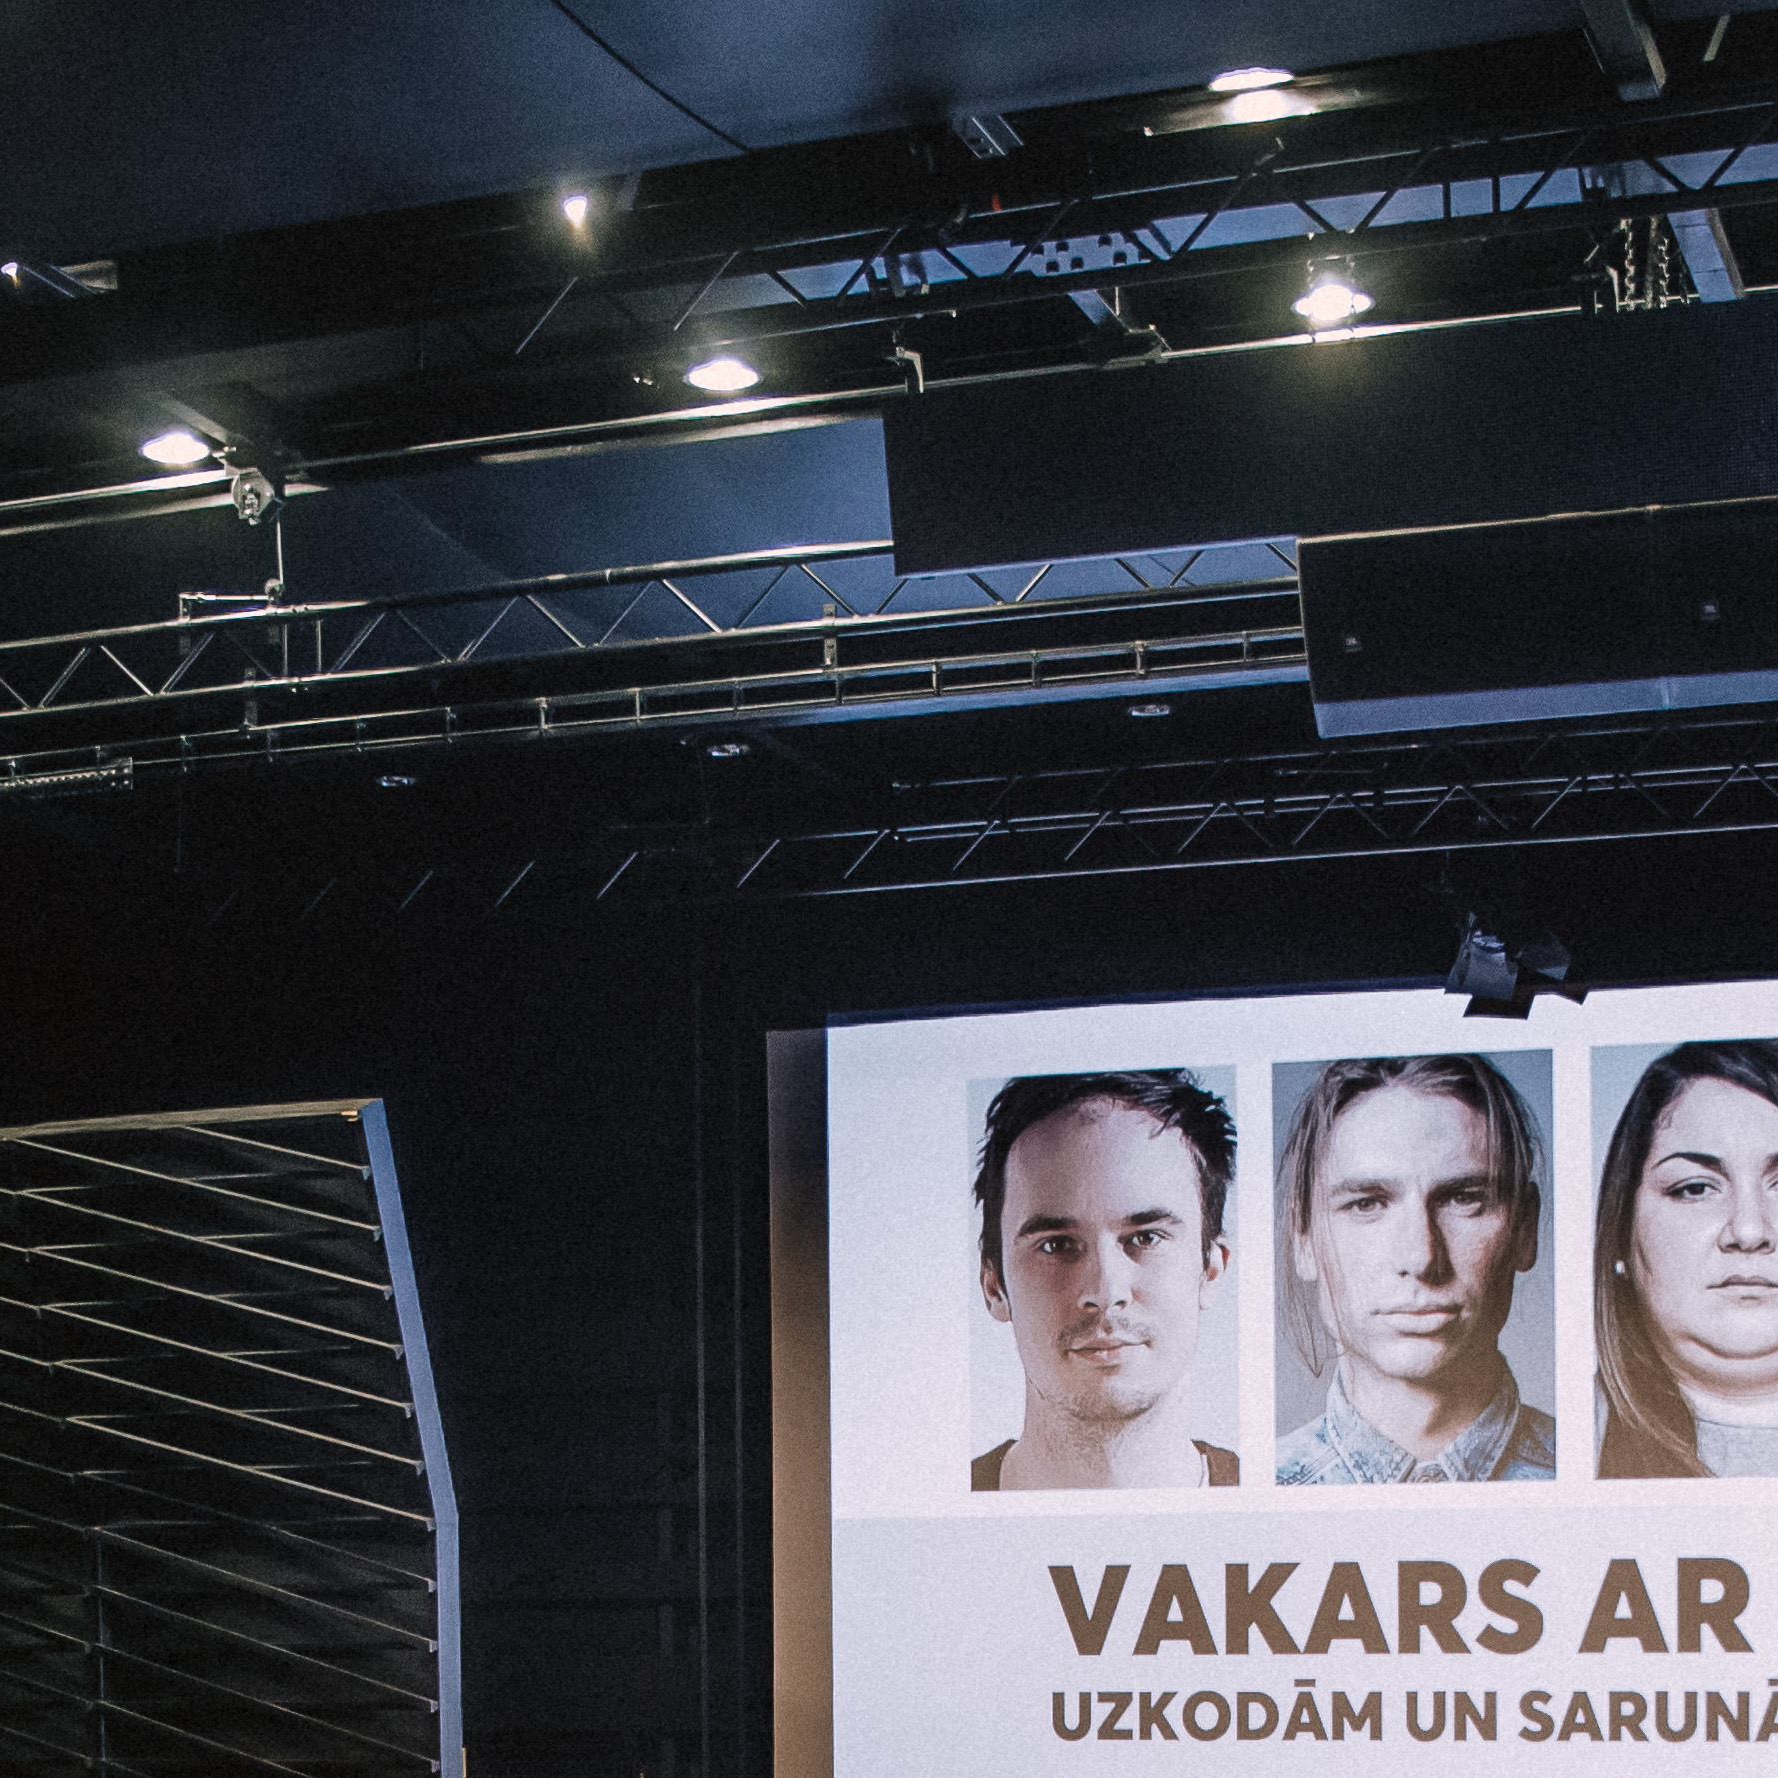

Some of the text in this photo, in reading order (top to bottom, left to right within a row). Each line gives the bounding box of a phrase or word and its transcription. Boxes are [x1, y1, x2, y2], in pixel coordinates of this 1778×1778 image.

[1047, 1557, 1545, 1657] VAKARS
[1577, 1556, 1754, 1654] AR
[1051, 1677, 1383, 1743] UZKODĀM
[1405, 1690, 1498, 1743] UN
